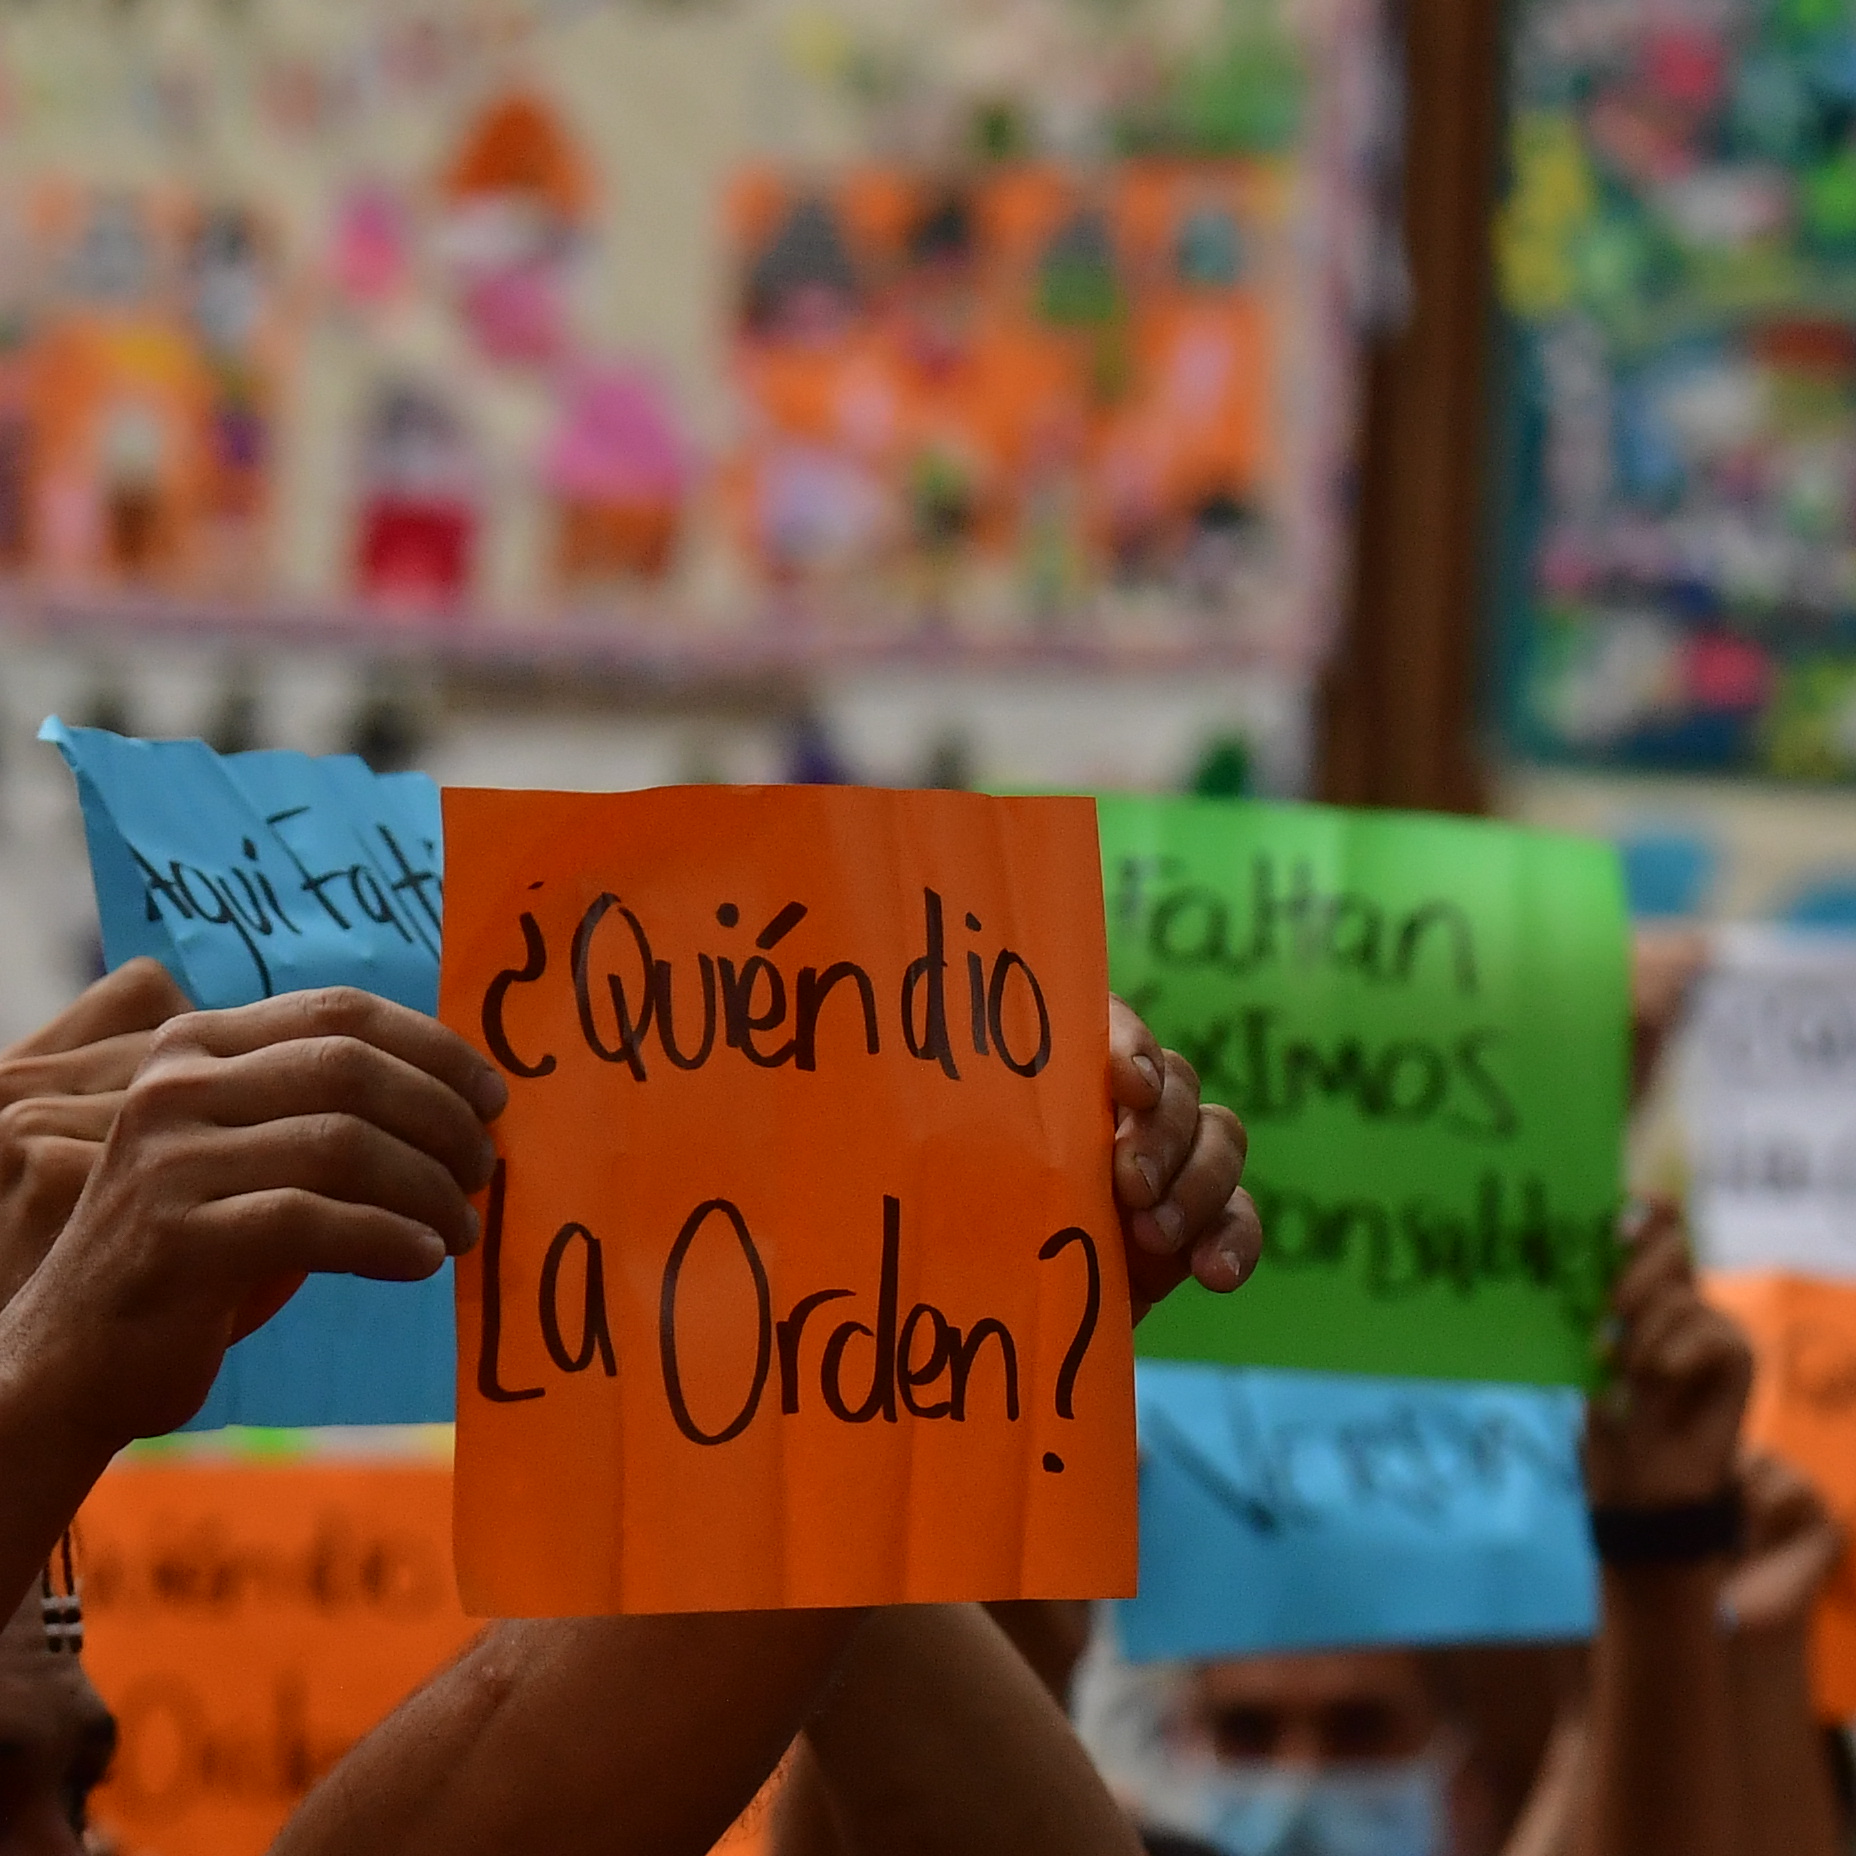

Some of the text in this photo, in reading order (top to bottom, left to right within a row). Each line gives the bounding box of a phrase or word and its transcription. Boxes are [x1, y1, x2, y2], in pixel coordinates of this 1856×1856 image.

[266, 805, 442, 962] Falt
[478, 1157, 1101, 1473] La Orden?
